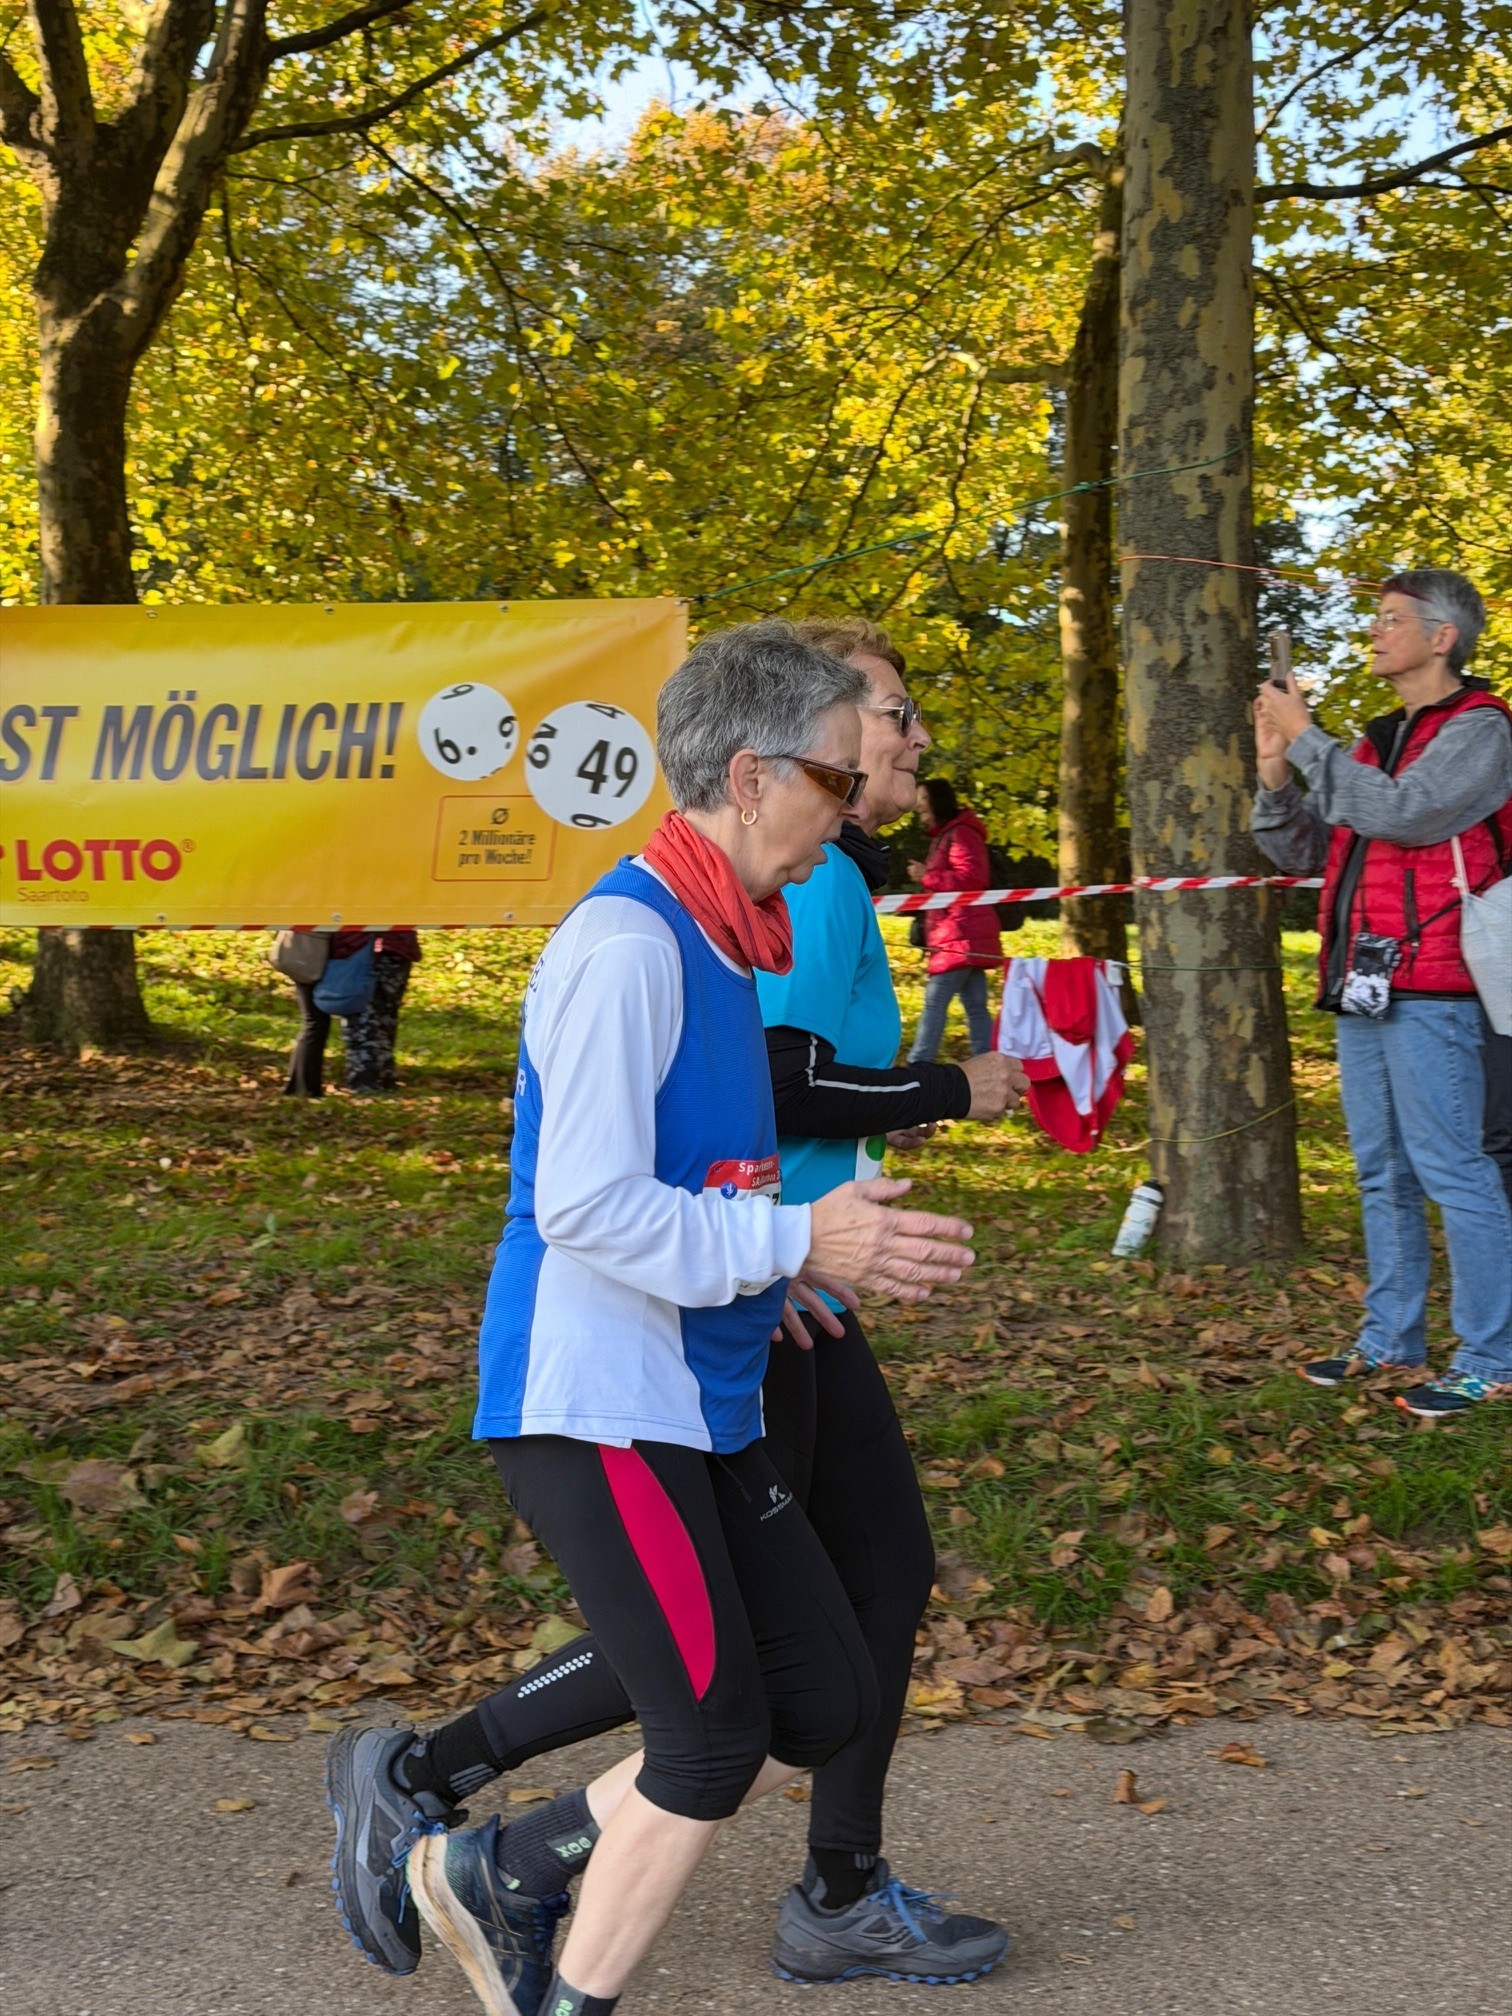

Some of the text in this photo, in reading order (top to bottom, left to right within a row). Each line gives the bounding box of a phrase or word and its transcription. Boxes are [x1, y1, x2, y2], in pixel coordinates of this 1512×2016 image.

[91, 690, 405, 781] MÖGLICH!
[576, 739, 638, 798] 49
[458, 830, 535, 846] 2 Millionäre
[457, 849, 533, 867] pro Woche!
